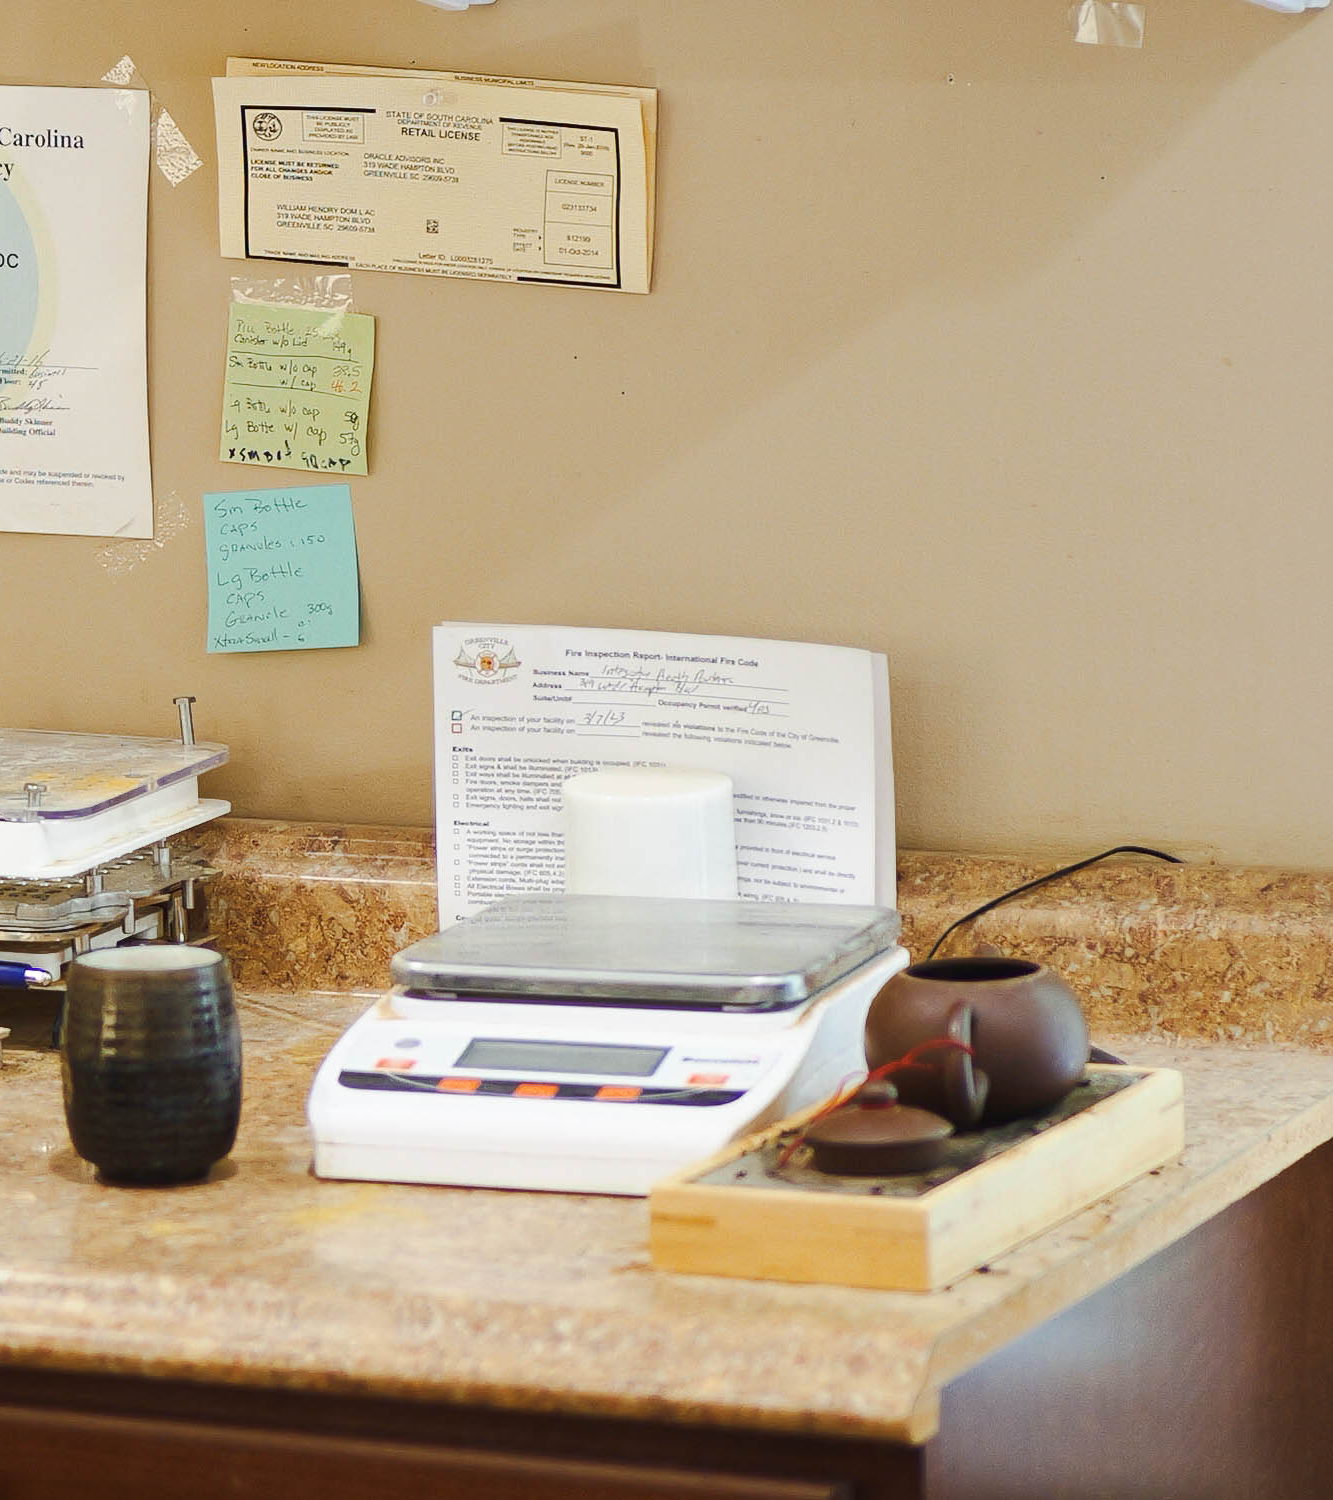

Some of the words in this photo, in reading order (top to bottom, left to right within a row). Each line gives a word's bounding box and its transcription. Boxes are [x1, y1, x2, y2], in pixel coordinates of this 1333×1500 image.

[401, 128, 442, 139] RETAIL
[444, 130, 481, 142] LICENSE
[565, 649, 582, 657] Fire
[585, 649, 633, 661] Inspection
